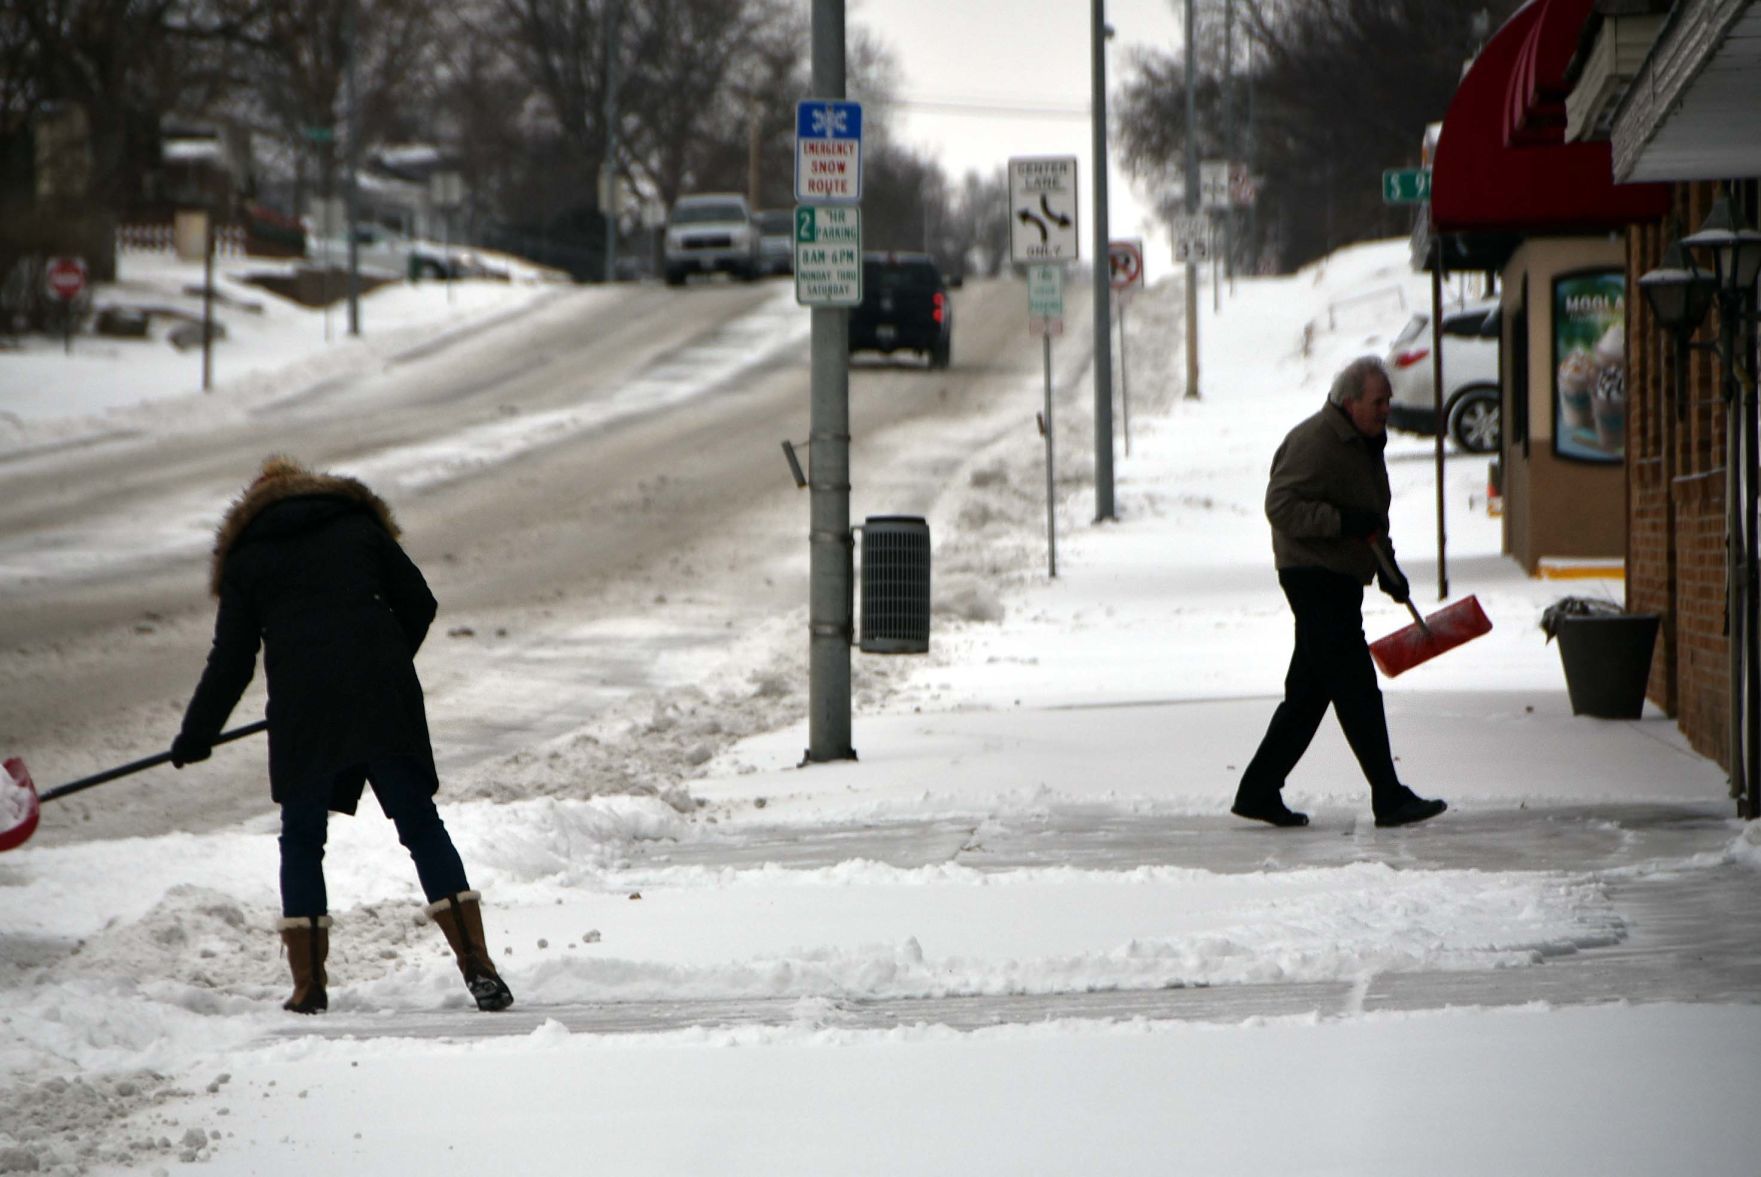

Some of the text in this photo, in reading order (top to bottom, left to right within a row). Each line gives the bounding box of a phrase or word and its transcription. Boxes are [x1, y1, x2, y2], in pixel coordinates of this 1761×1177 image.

[803, 142, 855, 155] EMERGENCY
[811, 160, 846, 175] SNOW
[807, 178, 848, 193] ROUTE
[1390, 171, 1401, 200] S
[829, 208, 846, 223] HR
[799, 210, 811, 239] 2
[816, 226, 857, 240] PARKING
[1026, 245, 1061, 258] ONLY
[799, 271, 857, 282] MONDAY THRU
[807, 284, 849, 296] SATURDAY
